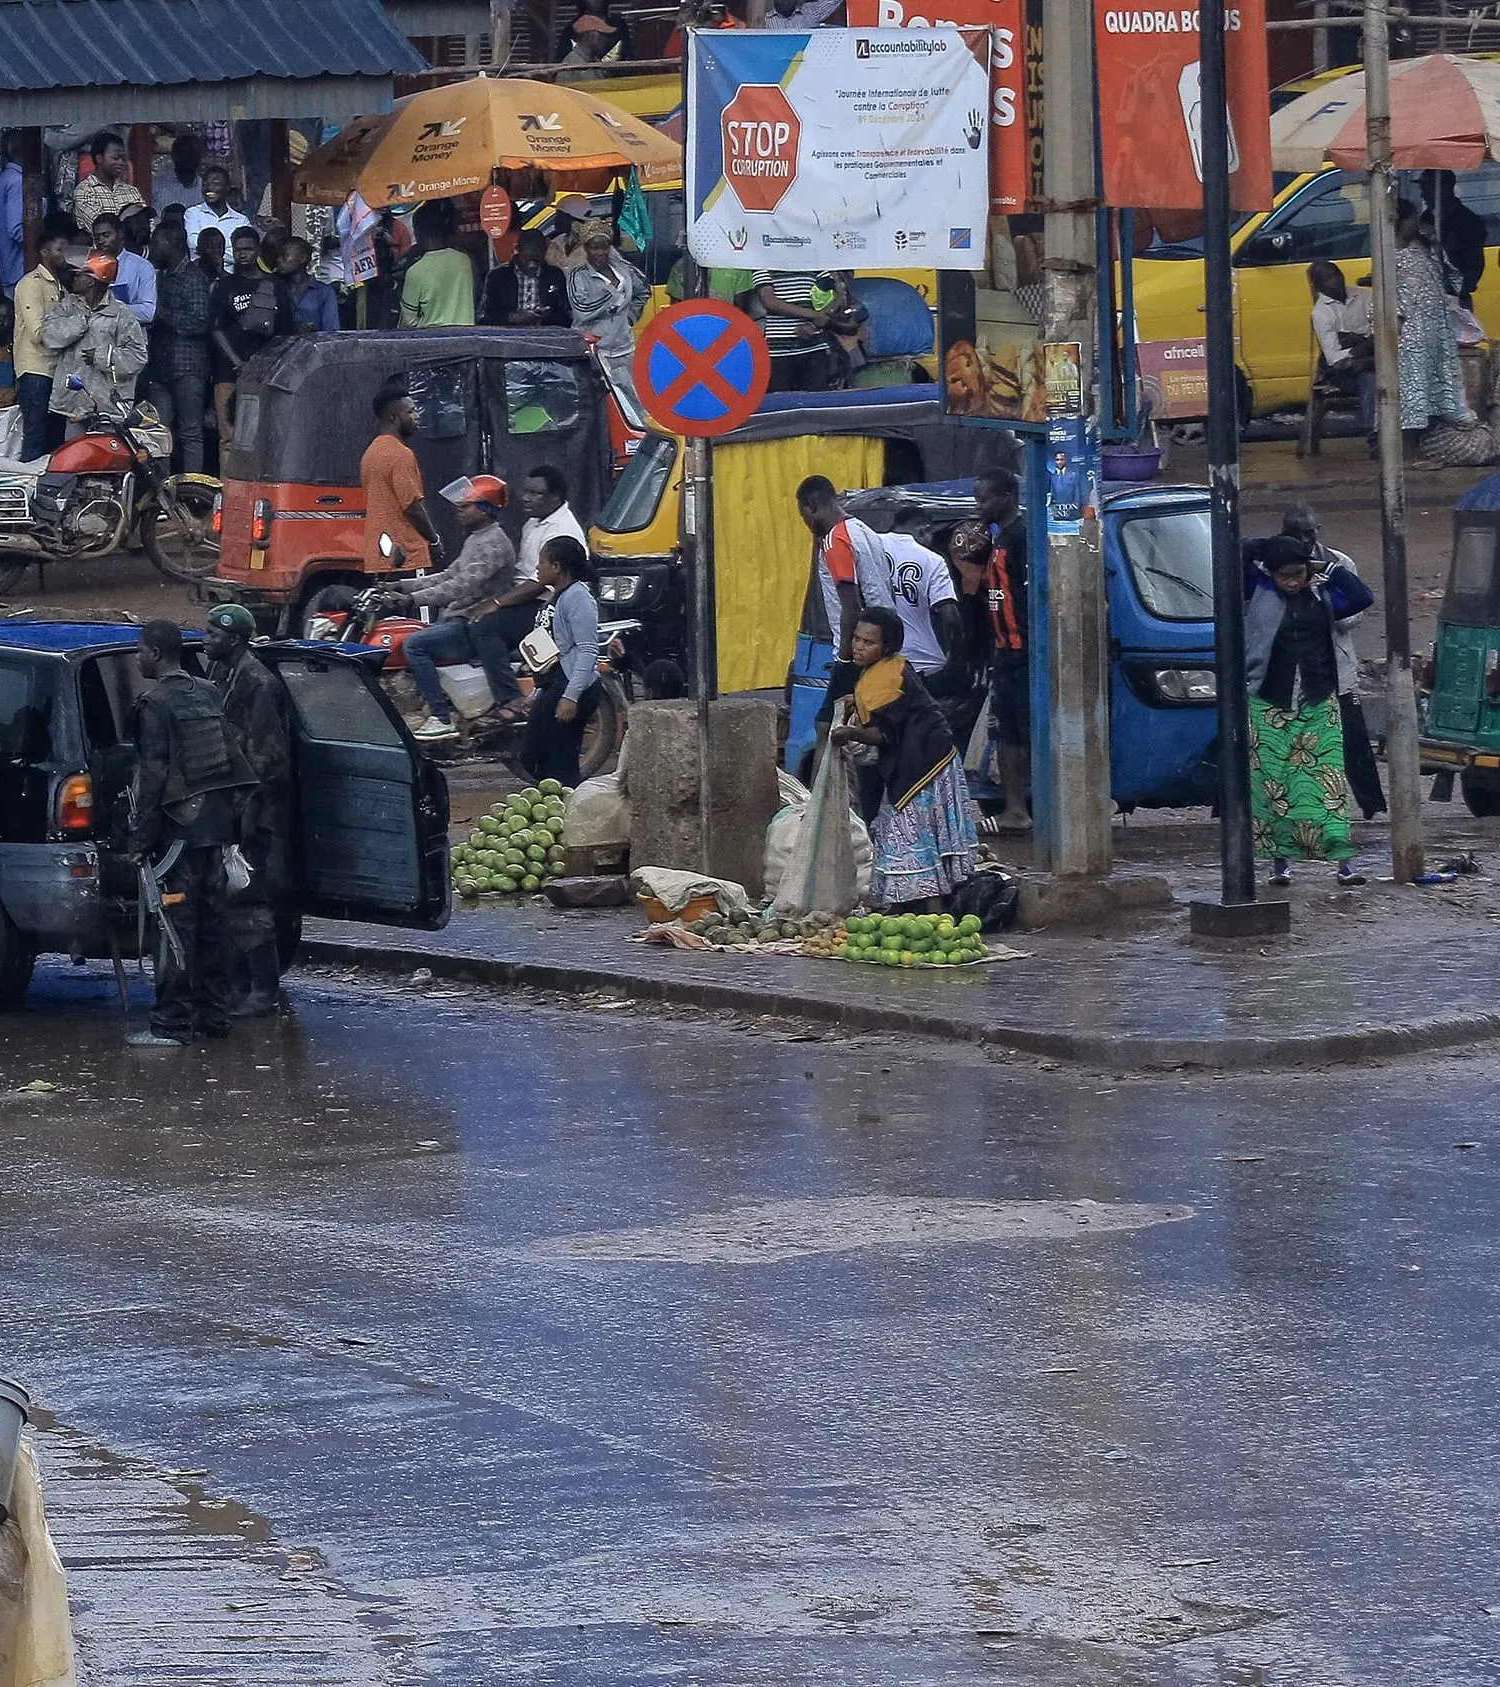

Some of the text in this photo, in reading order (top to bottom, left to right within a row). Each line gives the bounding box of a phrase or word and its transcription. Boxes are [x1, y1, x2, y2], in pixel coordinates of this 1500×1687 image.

[1105, 11, 1179, 33] QUADRA
[918, 87, 928, 97] de
[931, 86, 949, 96] lutte
[854, 103, 877, 111] contre
[879, 101, 886, 110] la
[526, 135, 571, 146] Orange
[727, 121, 790, 157] STOP
[414, 140, 459, 153] Orange
[530, 144, 571, 153] Money
[811, 150, 838, 159] Agissons
[950, 146, 966, 155] dans
[411, 151, 452, 163] Money
[731, 159, 789, 177] CORRUPTION
[834, 161, 843, 169] les
[936, 158, 943, 166] et
[418, 175, 480, 193] Orange Money
